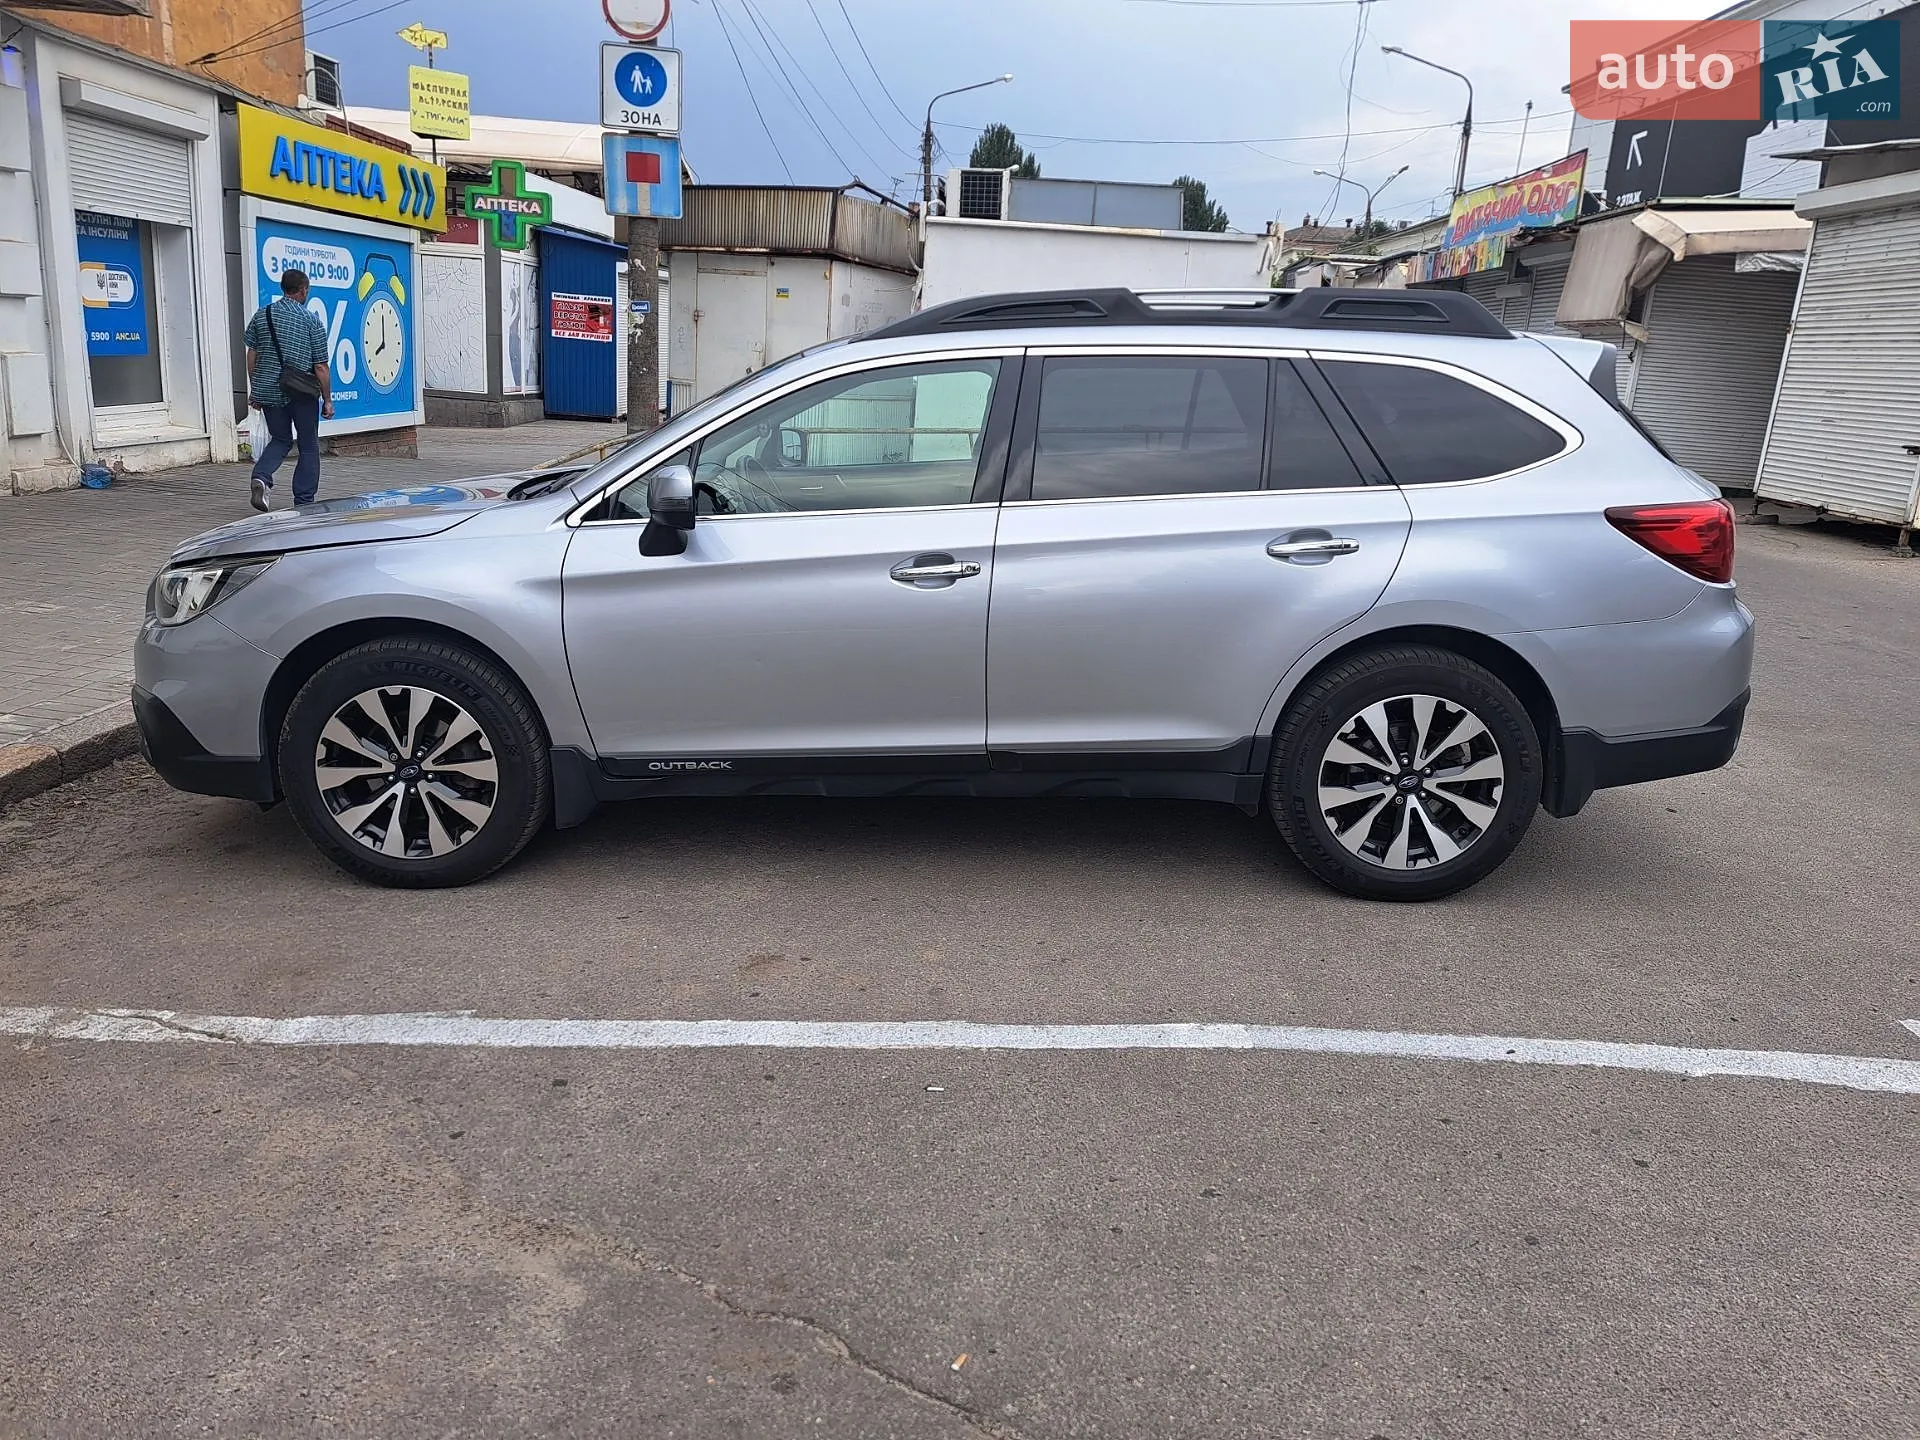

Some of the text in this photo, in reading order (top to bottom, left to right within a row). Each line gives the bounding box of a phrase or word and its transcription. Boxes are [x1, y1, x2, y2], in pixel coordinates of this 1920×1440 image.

[620, 110, 662, 126] ЗОНА
[270, 135, 387, 203] АПТЕКА
[474, 196, 542, 214] АПТЕКА
[1451, 181, 1578, 244] ДИТЯЧИЙ ОДЯГ
[76, 211, 112, 226] ОСТУПНІ
[88, 226, 129, 240] ІНСУЛІНИ
[285, 244, 337, 260] ГОДИНИ ТУРБОТИ
[309, 261, 325, 280] ДО
[327, 263, 349, 281] 9:00
[91, 331, 141, 341] 5900 ANC.UA
[330, 391, 358, 401] СІОНЕРІВ
[648, 761, 732, 770] OUTBACK
